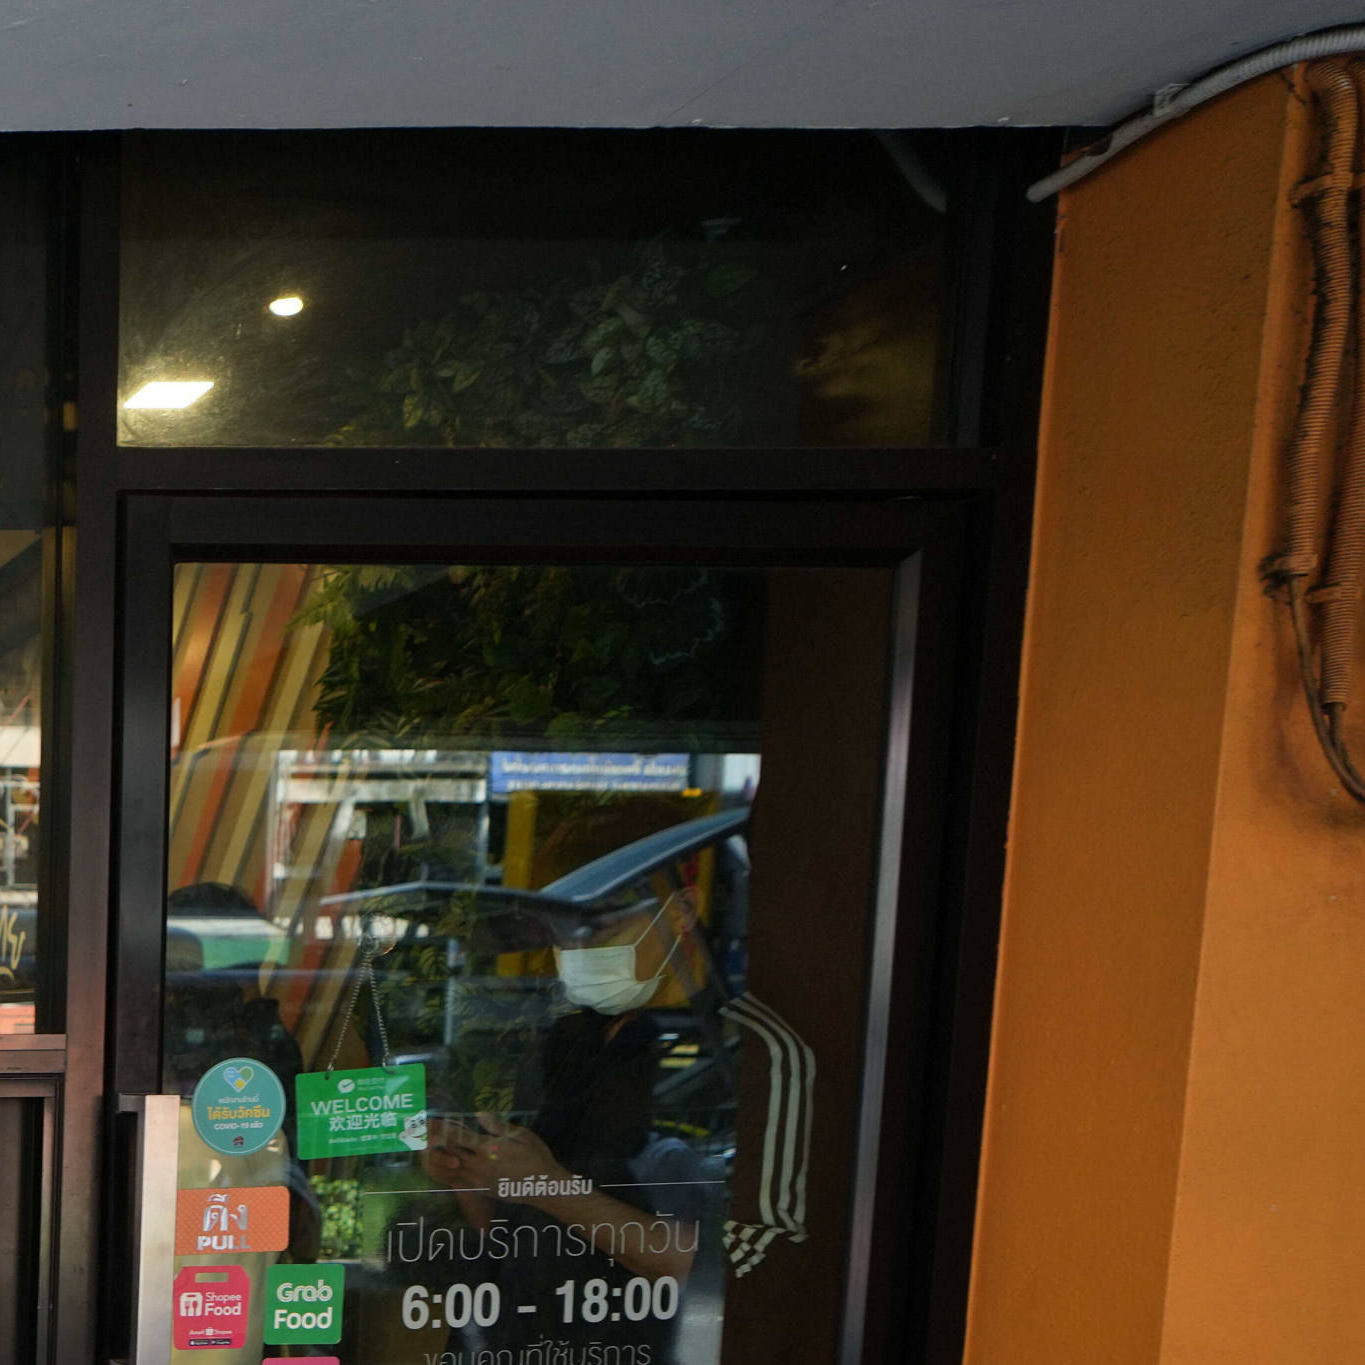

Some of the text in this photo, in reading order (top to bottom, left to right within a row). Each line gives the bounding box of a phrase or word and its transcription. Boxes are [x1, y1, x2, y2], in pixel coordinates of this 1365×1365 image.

[207, 1105, 270, 1120] ได้รับวัคซีน
[311, 1093, 414, 1116] WELCOME
[329, 1112, 398, 1132] 欢迎光临
[497, 1174, 594, 1198] ยินดีต้อนรับ
[197, 1234, 252, 1250] PULL
[386, 1210, 701, 1267] เปิดบริการทุกวัน
[205, 1292, 243, 1304] Shopee
[276, 1279, 334, 1303] Grab
[402, 1282, 501, 1329] 6:00
[555, 1275, 679, 1324] 18:00
[204, 1303, 242, 1317] Food
[273, 1307, 333, 1330] Food
